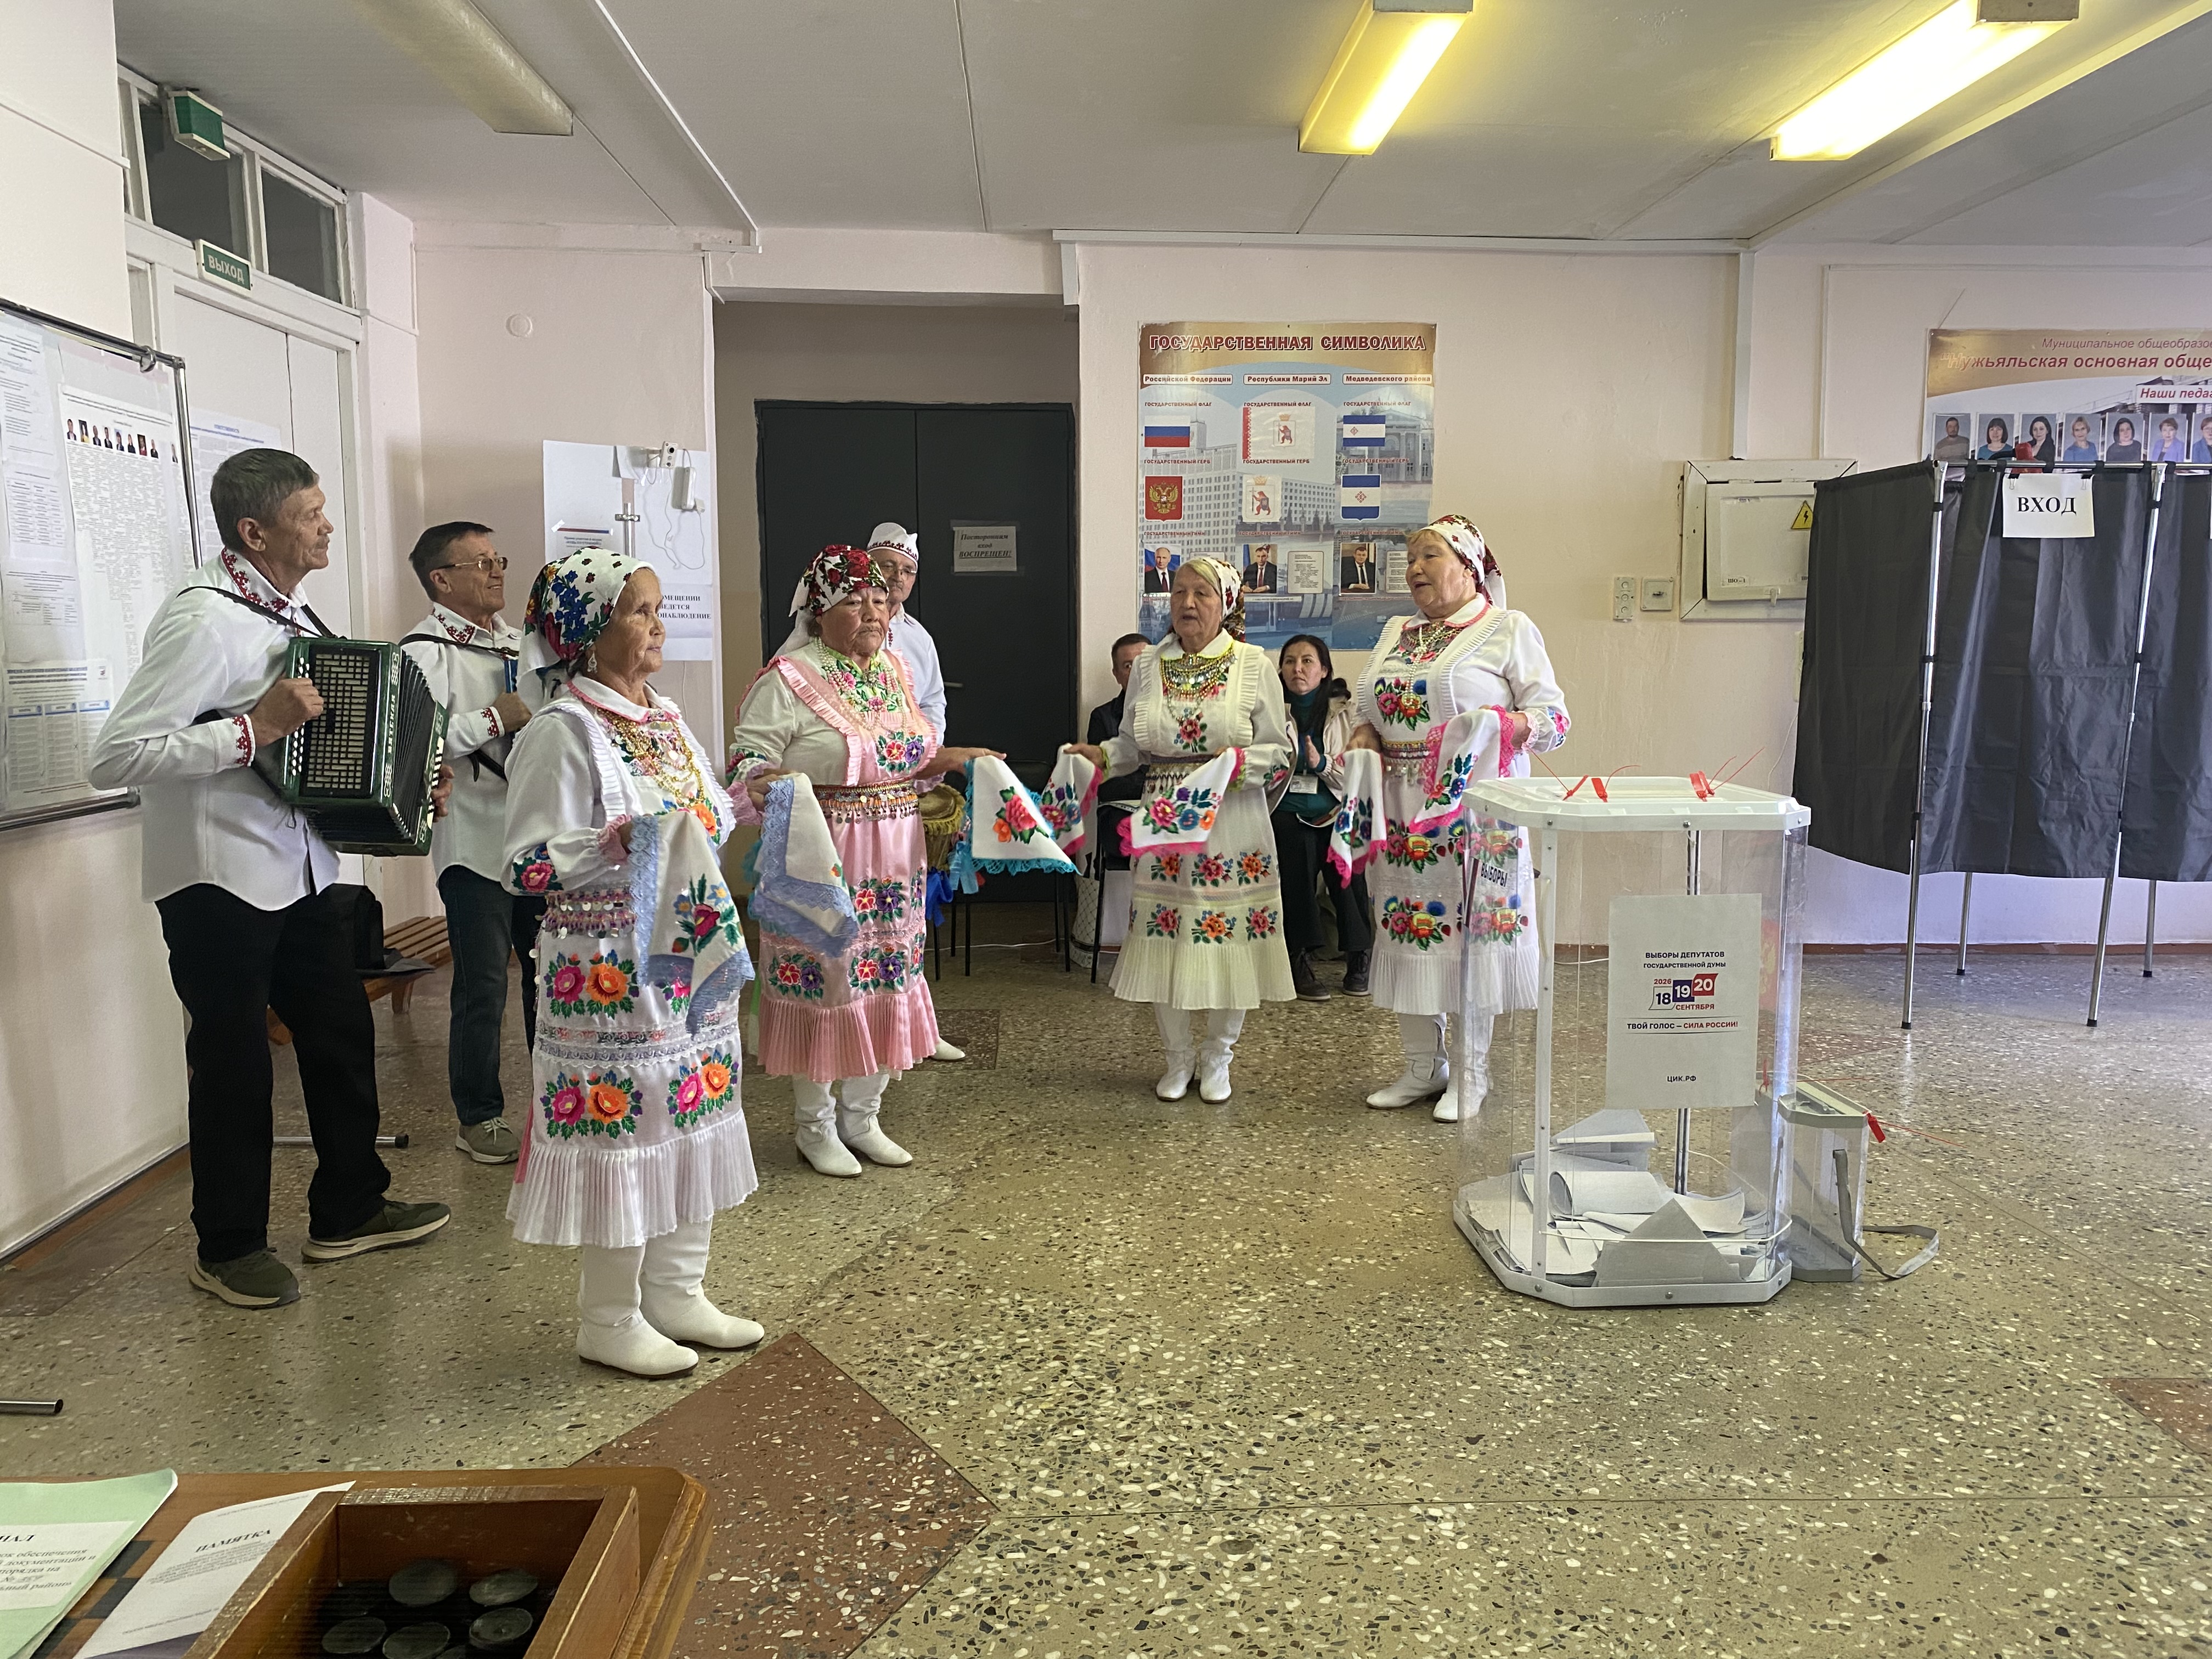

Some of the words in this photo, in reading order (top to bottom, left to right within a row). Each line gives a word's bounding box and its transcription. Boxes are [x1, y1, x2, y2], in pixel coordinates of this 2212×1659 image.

[207, 255, 245, 285] ВЫХОД
[1149, 335, 1313, 352] ГОСУДАРСТВЕННАЯ
[1320, 335, 1426, 351] СИМВОЛИКА
[2042, 338, 2135, 350] Муниципальное
[2073, 357, 2159, 368] основная
[2164, 353, 2212, 370] обще
[2140, 388, 2176, 398] Наши
[2017, 497, 2077, 516] ВХОД
[1481, 862, 1508, 887] ВЫБОРЫ
[1656, 992, 1671, 1005] 18
[1674, 985, 1691, 998] 19
[1694, 978, 1713, 991] 20
[195, 1529, 270, 1553] ПАМЯТКА
[3, 1556, 86, 1566] документации
[16, 1549, 88, 1558] обеспечения
